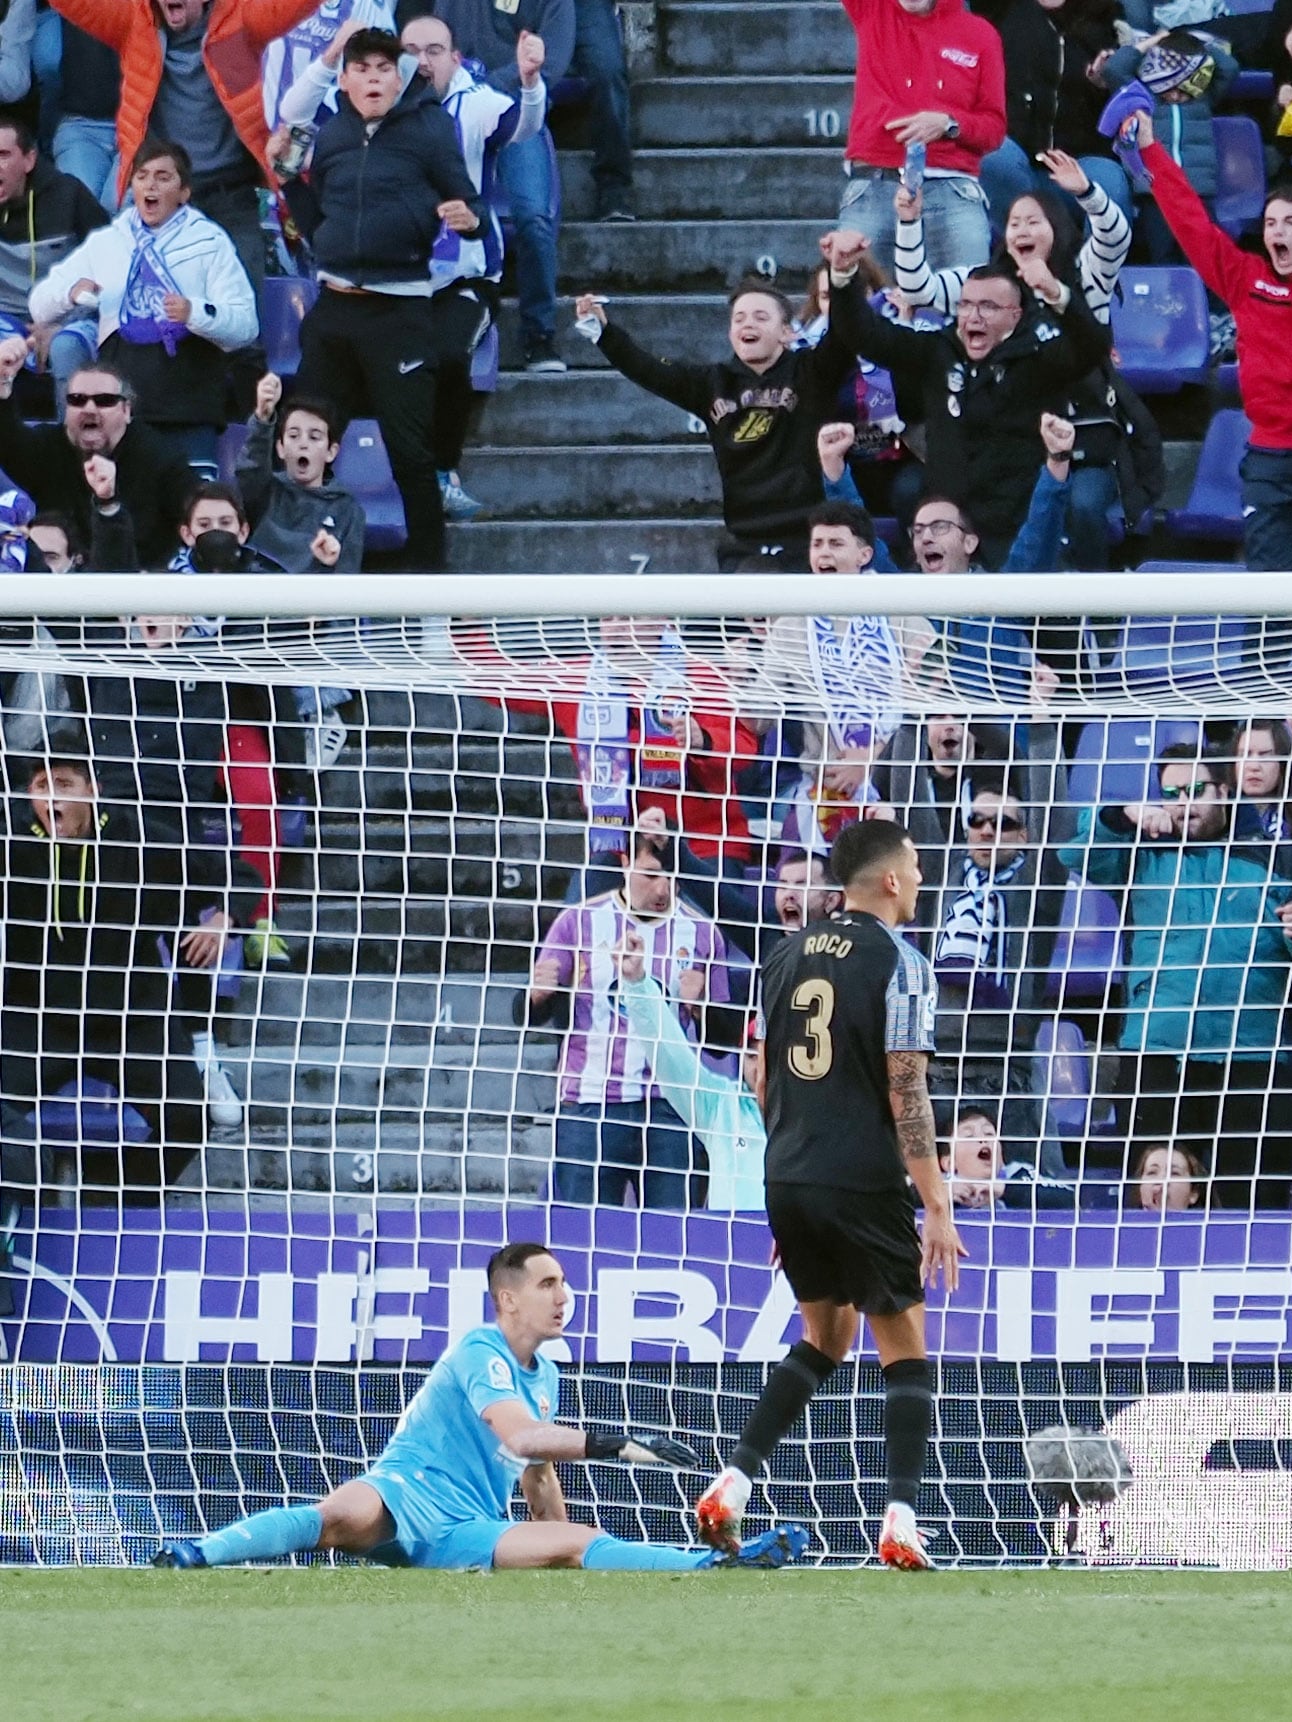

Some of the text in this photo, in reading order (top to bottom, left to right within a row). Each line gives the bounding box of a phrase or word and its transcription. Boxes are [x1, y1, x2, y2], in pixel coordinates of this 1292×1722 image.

[804, 108, 841, 138] 10
[630, 554, 650, 576] 7
[502, 860, 521, 889] 5
[804, 933, 854, 959] ROCO
[435, 1003, 456, 1034] 4
[787, 978, 835, 1081] 3
[352, 1152, 373, 1184] 3
